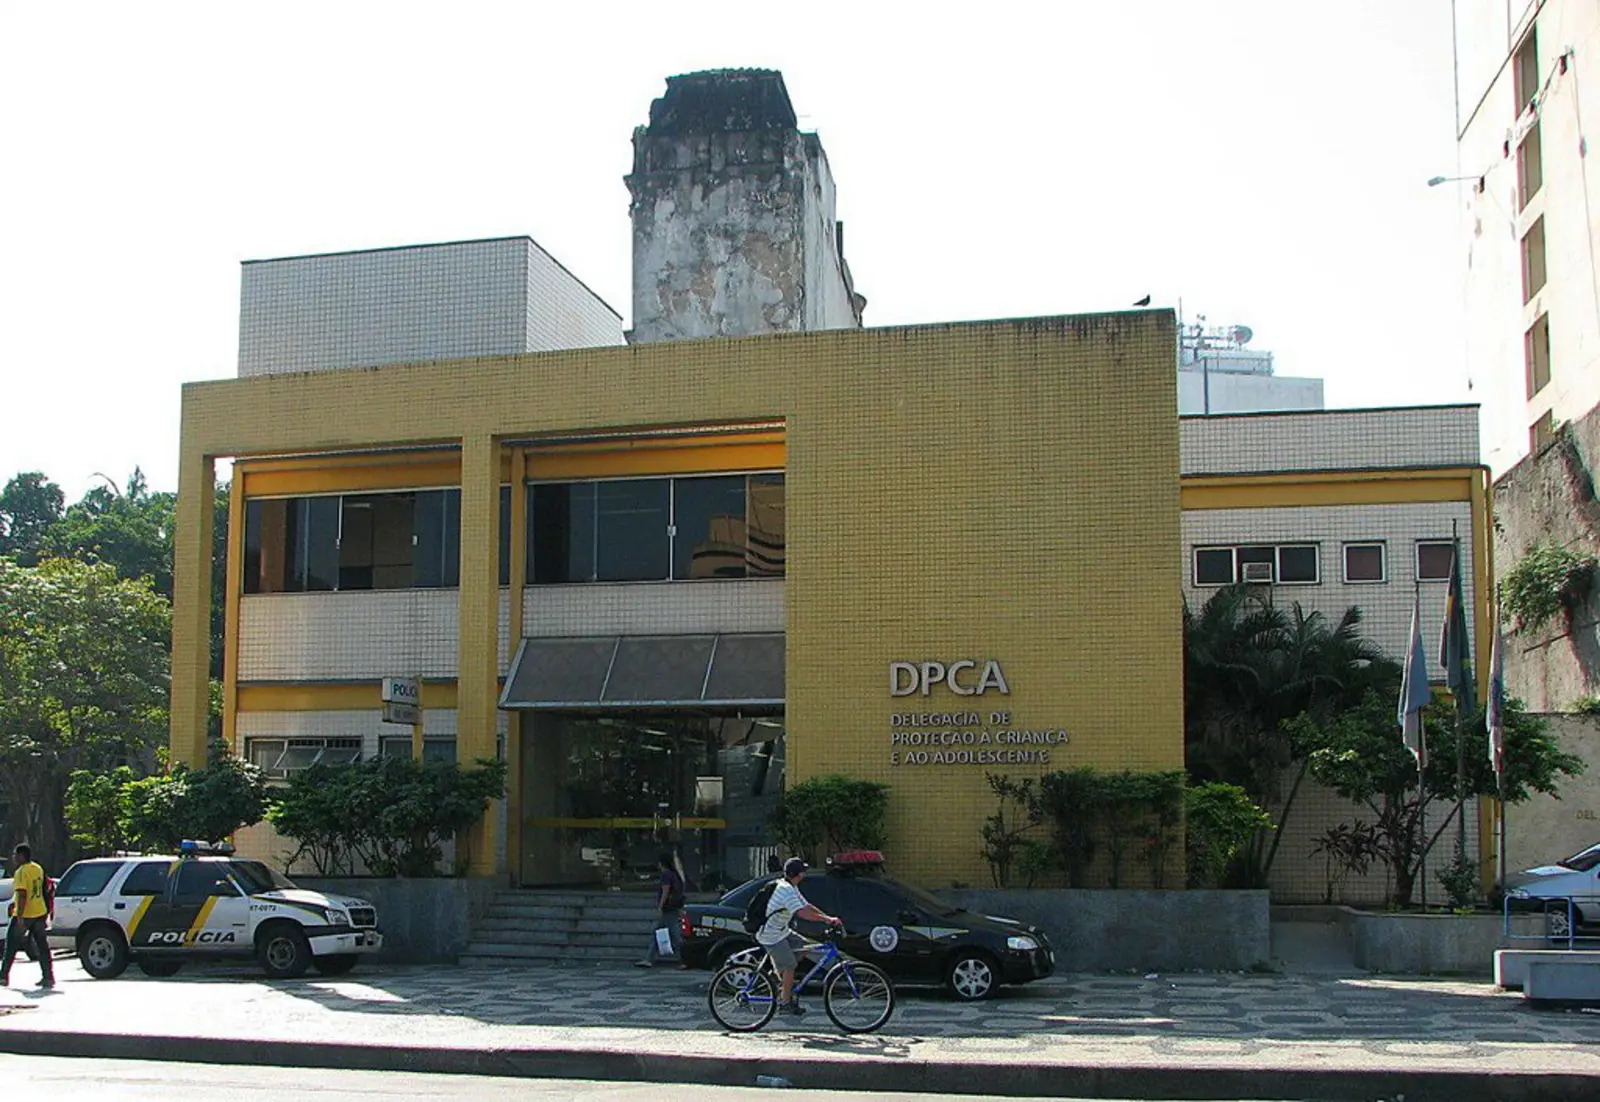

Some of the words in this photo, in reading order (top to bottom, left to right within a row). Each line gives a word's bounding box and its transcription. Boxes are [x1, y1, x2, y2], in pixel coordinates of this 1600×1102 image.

[890, 660, 1010, 696] DPCA
[890, 711, 980, 728] DELEGACIA
[989, 711, 1011, 726] DE
[890, 751, 900, 766] E
[904, 750, 929, 765] AO
[932, 749, 1050, 765] ADOLESCENTE
